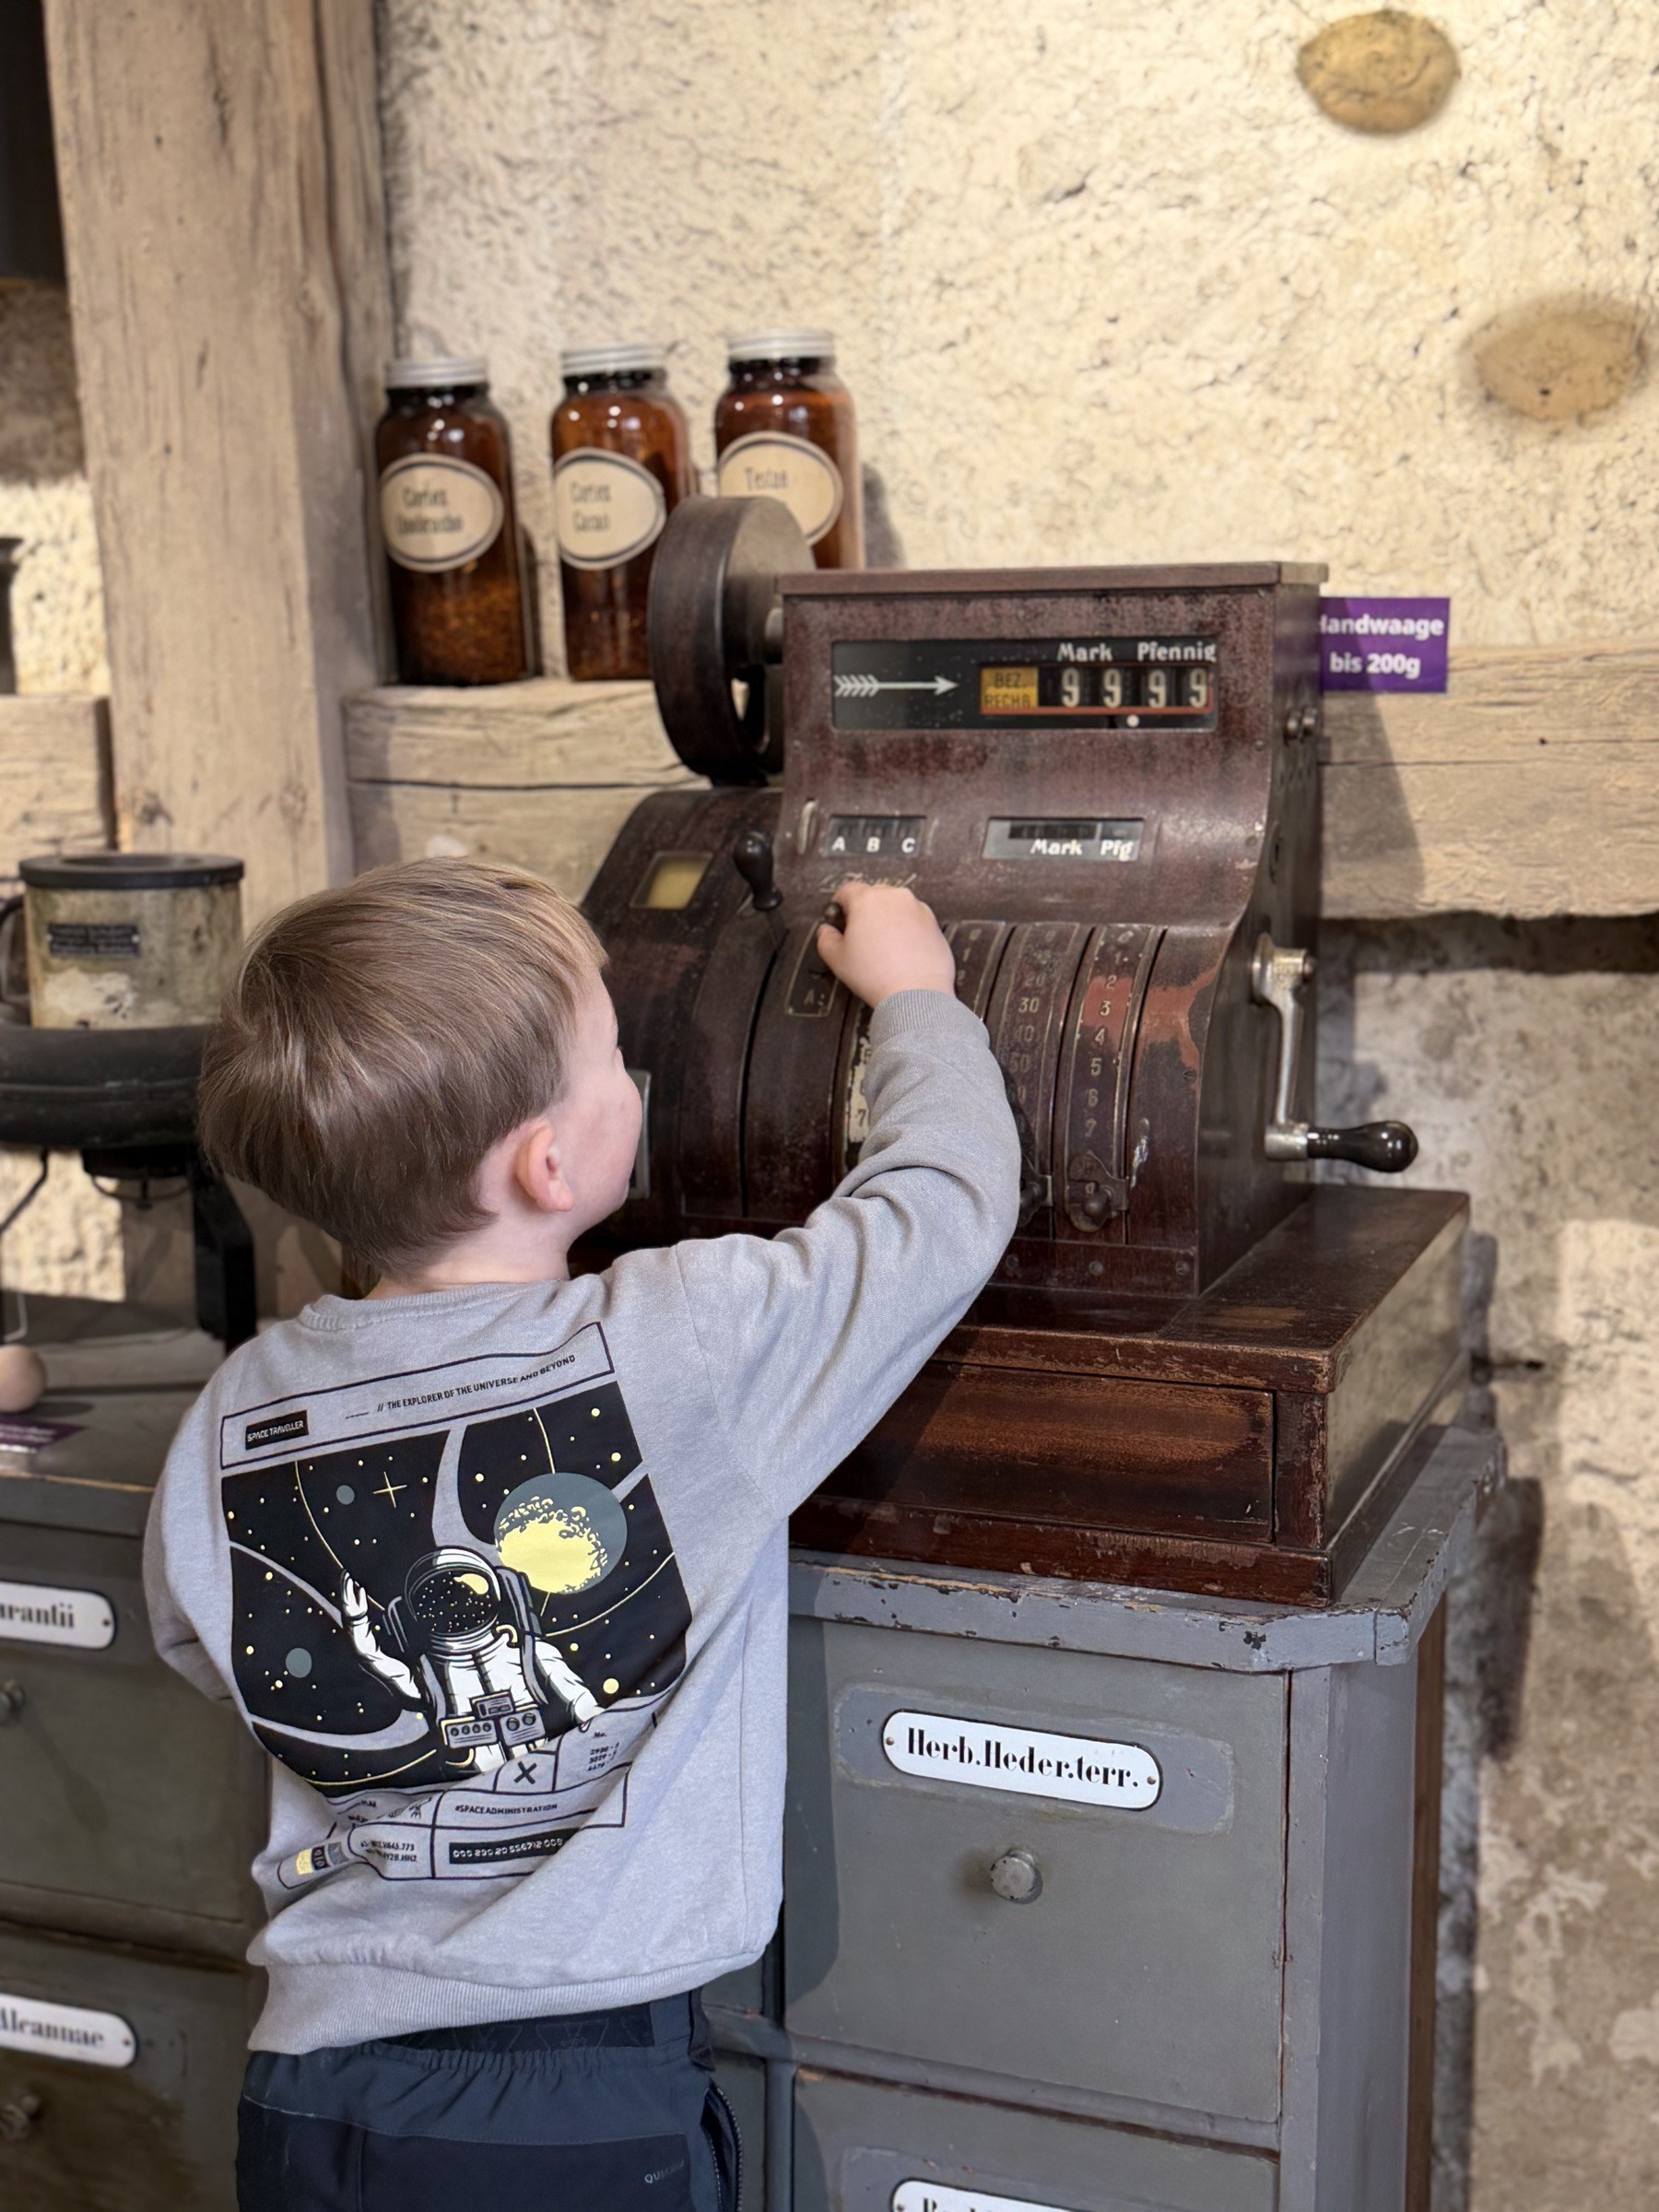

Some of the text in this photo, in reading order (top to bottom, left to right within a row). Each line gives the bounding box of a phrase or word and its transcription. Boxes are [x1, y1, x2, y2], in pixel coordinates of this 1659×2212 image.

[1057, 641, 1217, 662] Mark Pfennig
[1330, 652, 1421, 680] bis 200g
[1062, 666, 1206, 709] 9 9 9 9
[831, 836, 916, 853] A B C
[1030, 839, 1083, 855] Mark
[1106, 974, 1117, 990] 2
[1018, 996, 1040, 1014] 30
[1100, 1000, 1112, 1017] 3
[1094, 1028, 1105, 1045] 4
[1090, 1057, 1102, 1077] 5
[1088, 1088, 1099, 1108] 6
[1085, 1118, 1097, 1138] 7
[387, 1399, 402, 1410] THE
[403, 1391, 443, 1407] EXPLORER
[444, 1388, 455, 1399] OF
[455, 1385, 473, 1396] THE
[474, 1376, 519, 1392] UNIVERSE
[520, 1371, 539, 1382] AND
[540, 1354, 576, 1375] BEYOND
[247, 1420, 304, 1442] SPACE TRAVELLER
